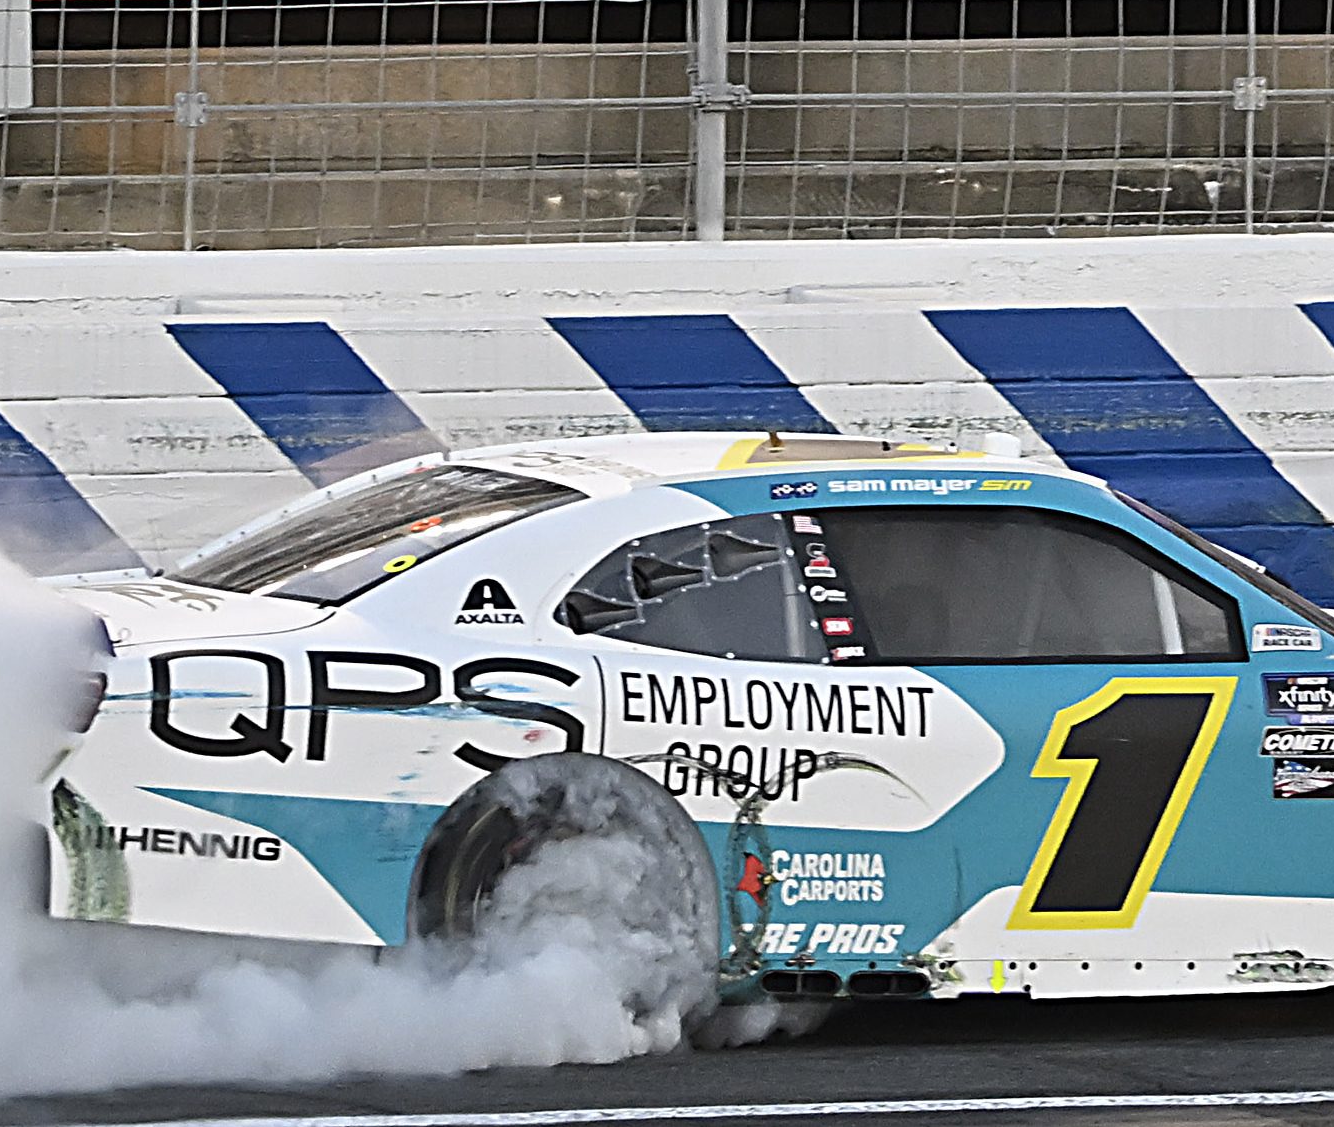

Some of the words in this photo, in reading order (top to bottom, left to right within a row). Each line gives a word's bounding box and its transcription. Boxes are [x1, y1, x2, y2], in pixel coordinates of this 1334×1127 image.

[827, 479, 886, 493] sam
[890, 478, 977, 496] mayer
[454, 612, 525, 626] AXALTA
[1262, 638, 1289, 647] RACE
[1292, 638, 1313, 647] CAR
[149, 648, 585, 775] QPS
[621, 671, 934, 739] EMPLOYMENT
[663, 741, 819, 803] GROUP
[1006, 675, 1239, 931] 1
[119, 826, 282, 862] HENNIG
[771, 849, 886, 881] CAROLINA
[780, 878, 885, 906] CARPORTS
[806, 922, 906, 955] PROS
